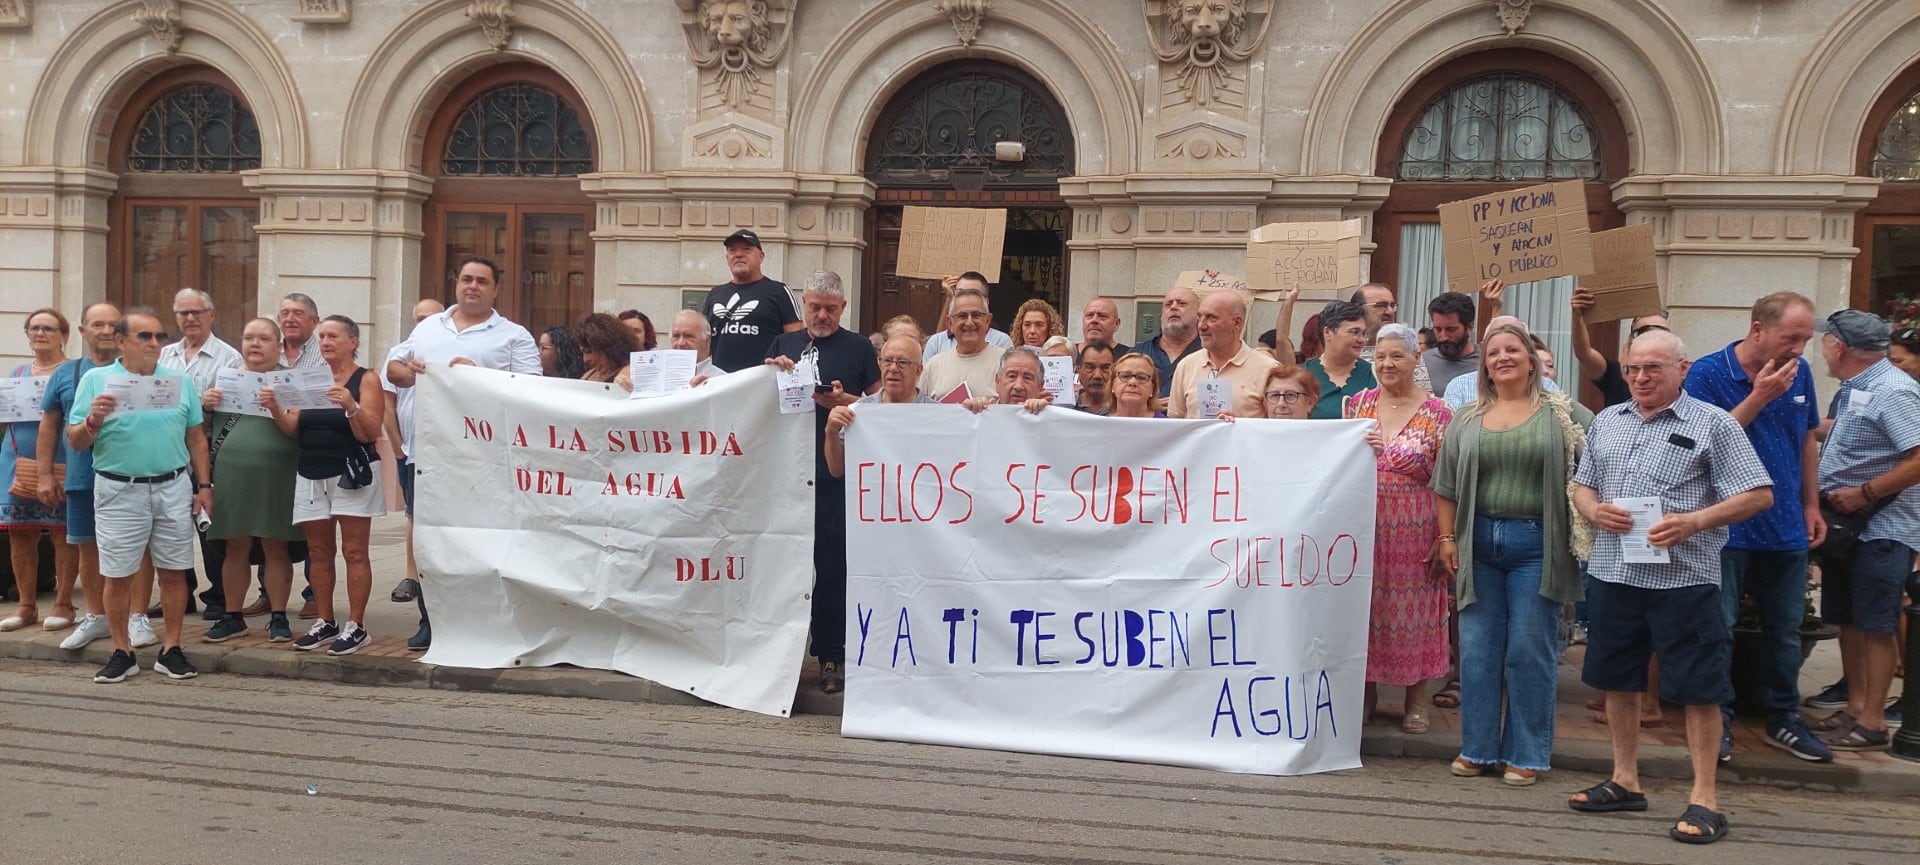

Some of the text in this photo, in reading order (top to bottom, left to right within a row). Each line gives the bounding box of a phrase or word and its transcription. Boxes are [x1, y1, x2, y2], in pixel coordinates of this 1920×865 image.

[1473, 191, 1556, 222] PP Y ACCIONA
[1479, 219, 1534, 243] SAQUEAN
[1493, 233, 1552, 256] Y ATACAN
[1274, 256, 1338, 270] ACCIONA
[1295, 246, 1305, 259] Y
[1273, 270, 1338, 284] TE ROBAN
[1481, 262, 1501, 280] LO
[712, 321, 760, 336] idas
[463, 416, 743, 456] NO A LA SUBIDA
[515, 468, 685, 500] DEL AGUA
[858, 461, 1248, 525] ELLOS SE SUBEN EL
[675, 554, 746, 582] DLU
[1203, 533, 1359, 589] SUELDO
[857, 602, 873, 667] Y
[891, 606, 918, 668] A
[1009, 608, 1060, 666] TE
[1074, 607, 1190, 669] SUBEN
[1207, 608, 1258, 668] EL
[1210, 670, 1338, 740] AGUA
